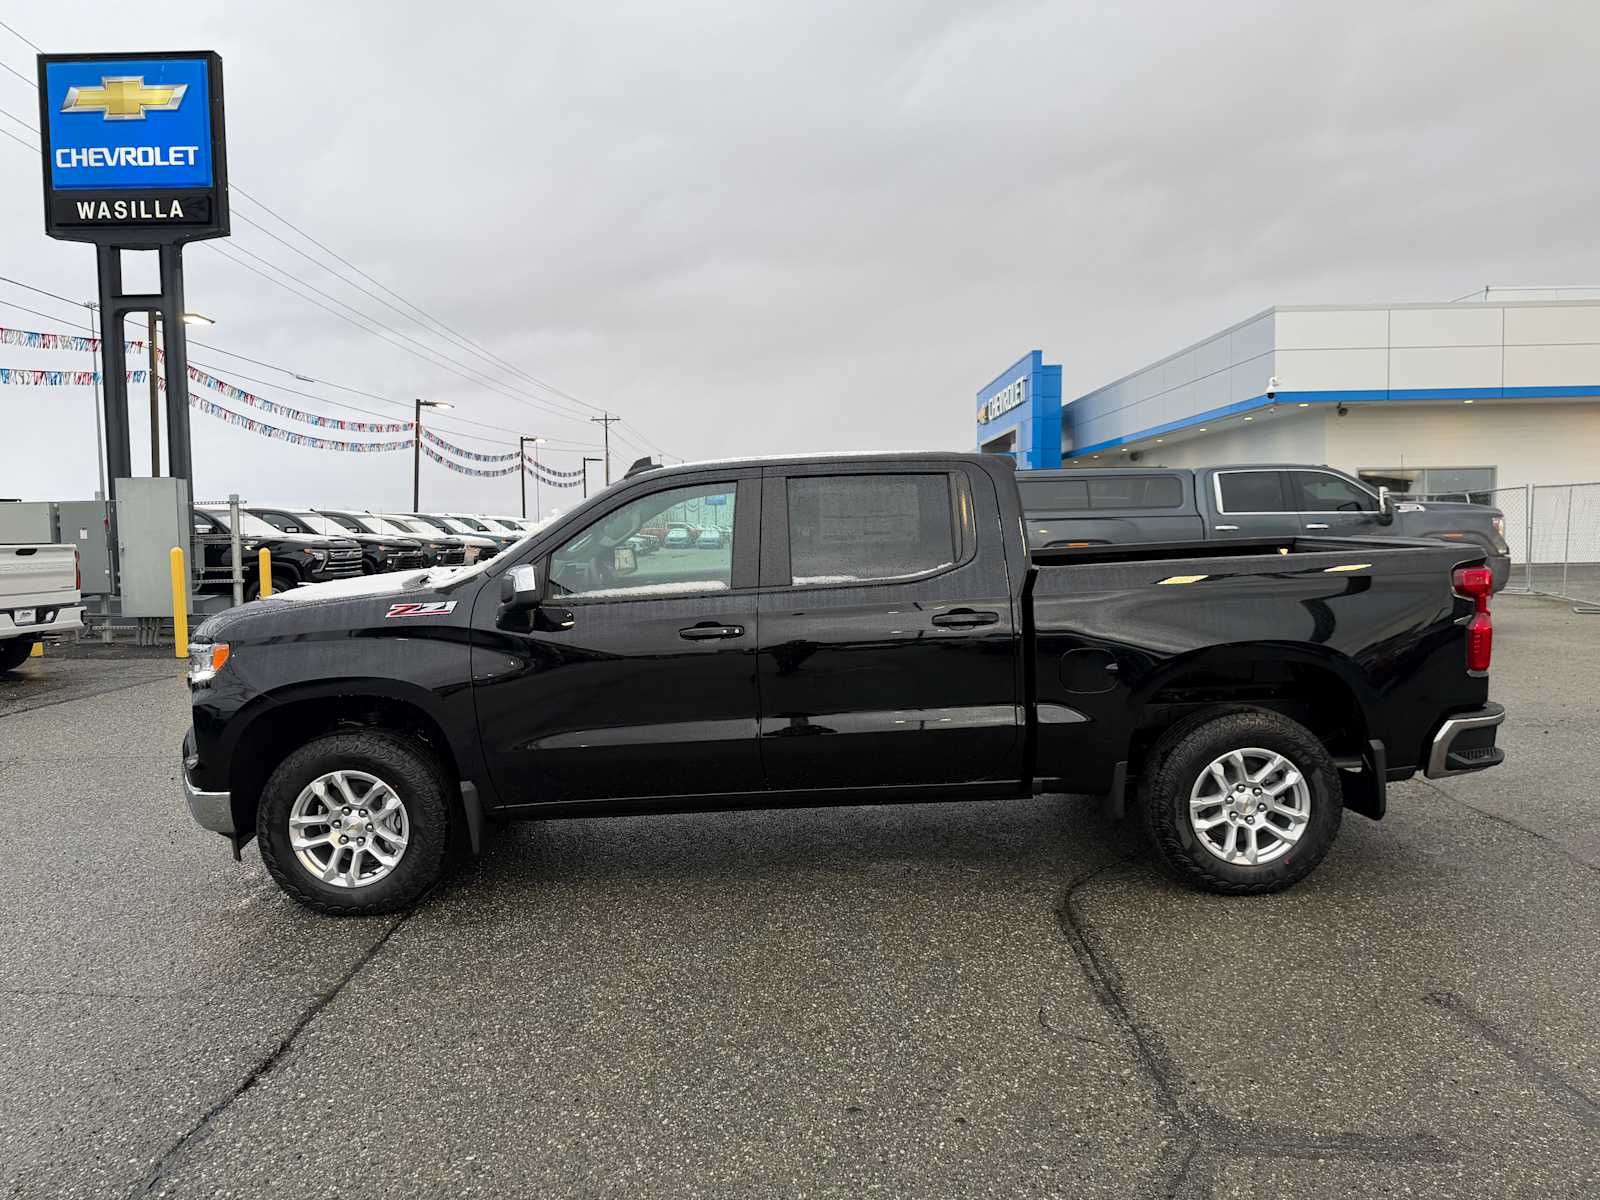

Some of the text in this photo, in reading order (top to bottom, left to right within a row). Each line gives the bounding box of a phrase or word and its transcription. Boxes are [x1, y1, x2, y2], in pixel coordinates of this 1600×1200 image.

[56, 146, 199, 168] CHEVROLET
[76, 200, 184, 220] WASILLA
[988, 376, 1027, 420] CHEVROLET
[385, 601, 458, 618] Z71
